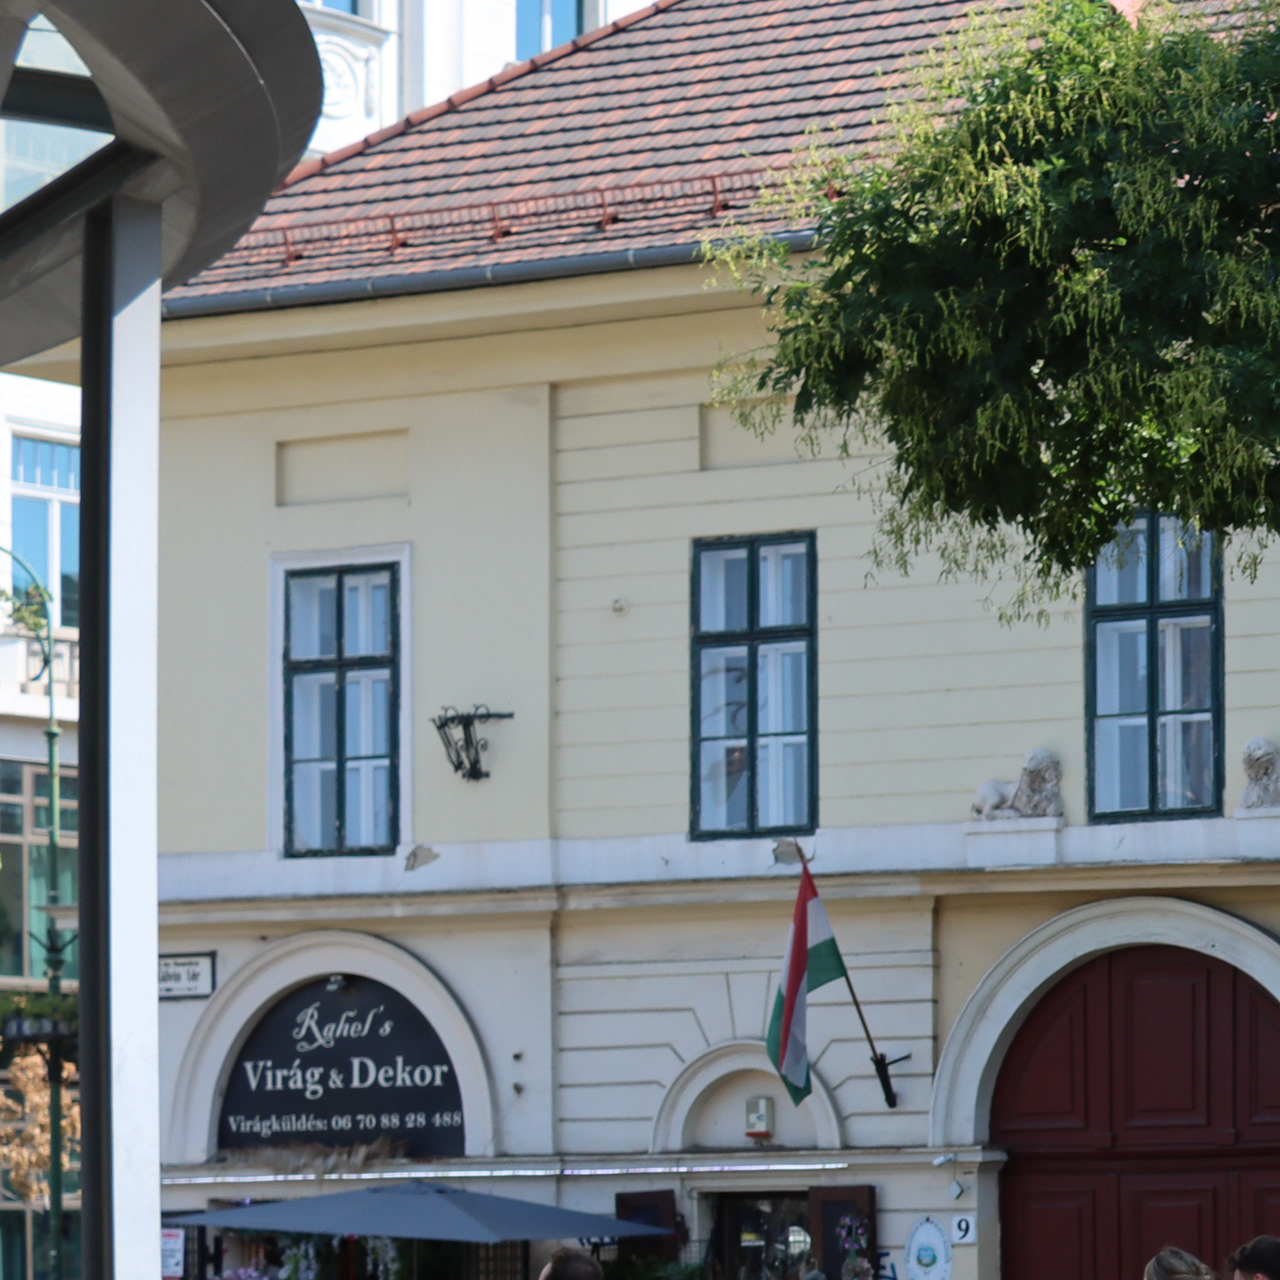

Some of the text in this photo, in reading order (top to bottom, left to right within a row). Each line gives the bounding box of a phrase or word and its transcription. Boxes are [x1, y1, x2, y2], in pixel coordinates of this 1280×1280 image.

[292, 1002, 394, 1052] Rahel's
[243, 1055, 449, 1100] Virág & Dekor
[227, 1111, 462, 1138] Virágküldés: 06 70 88 28 488
[957, 1218, 970, 1240] 9
